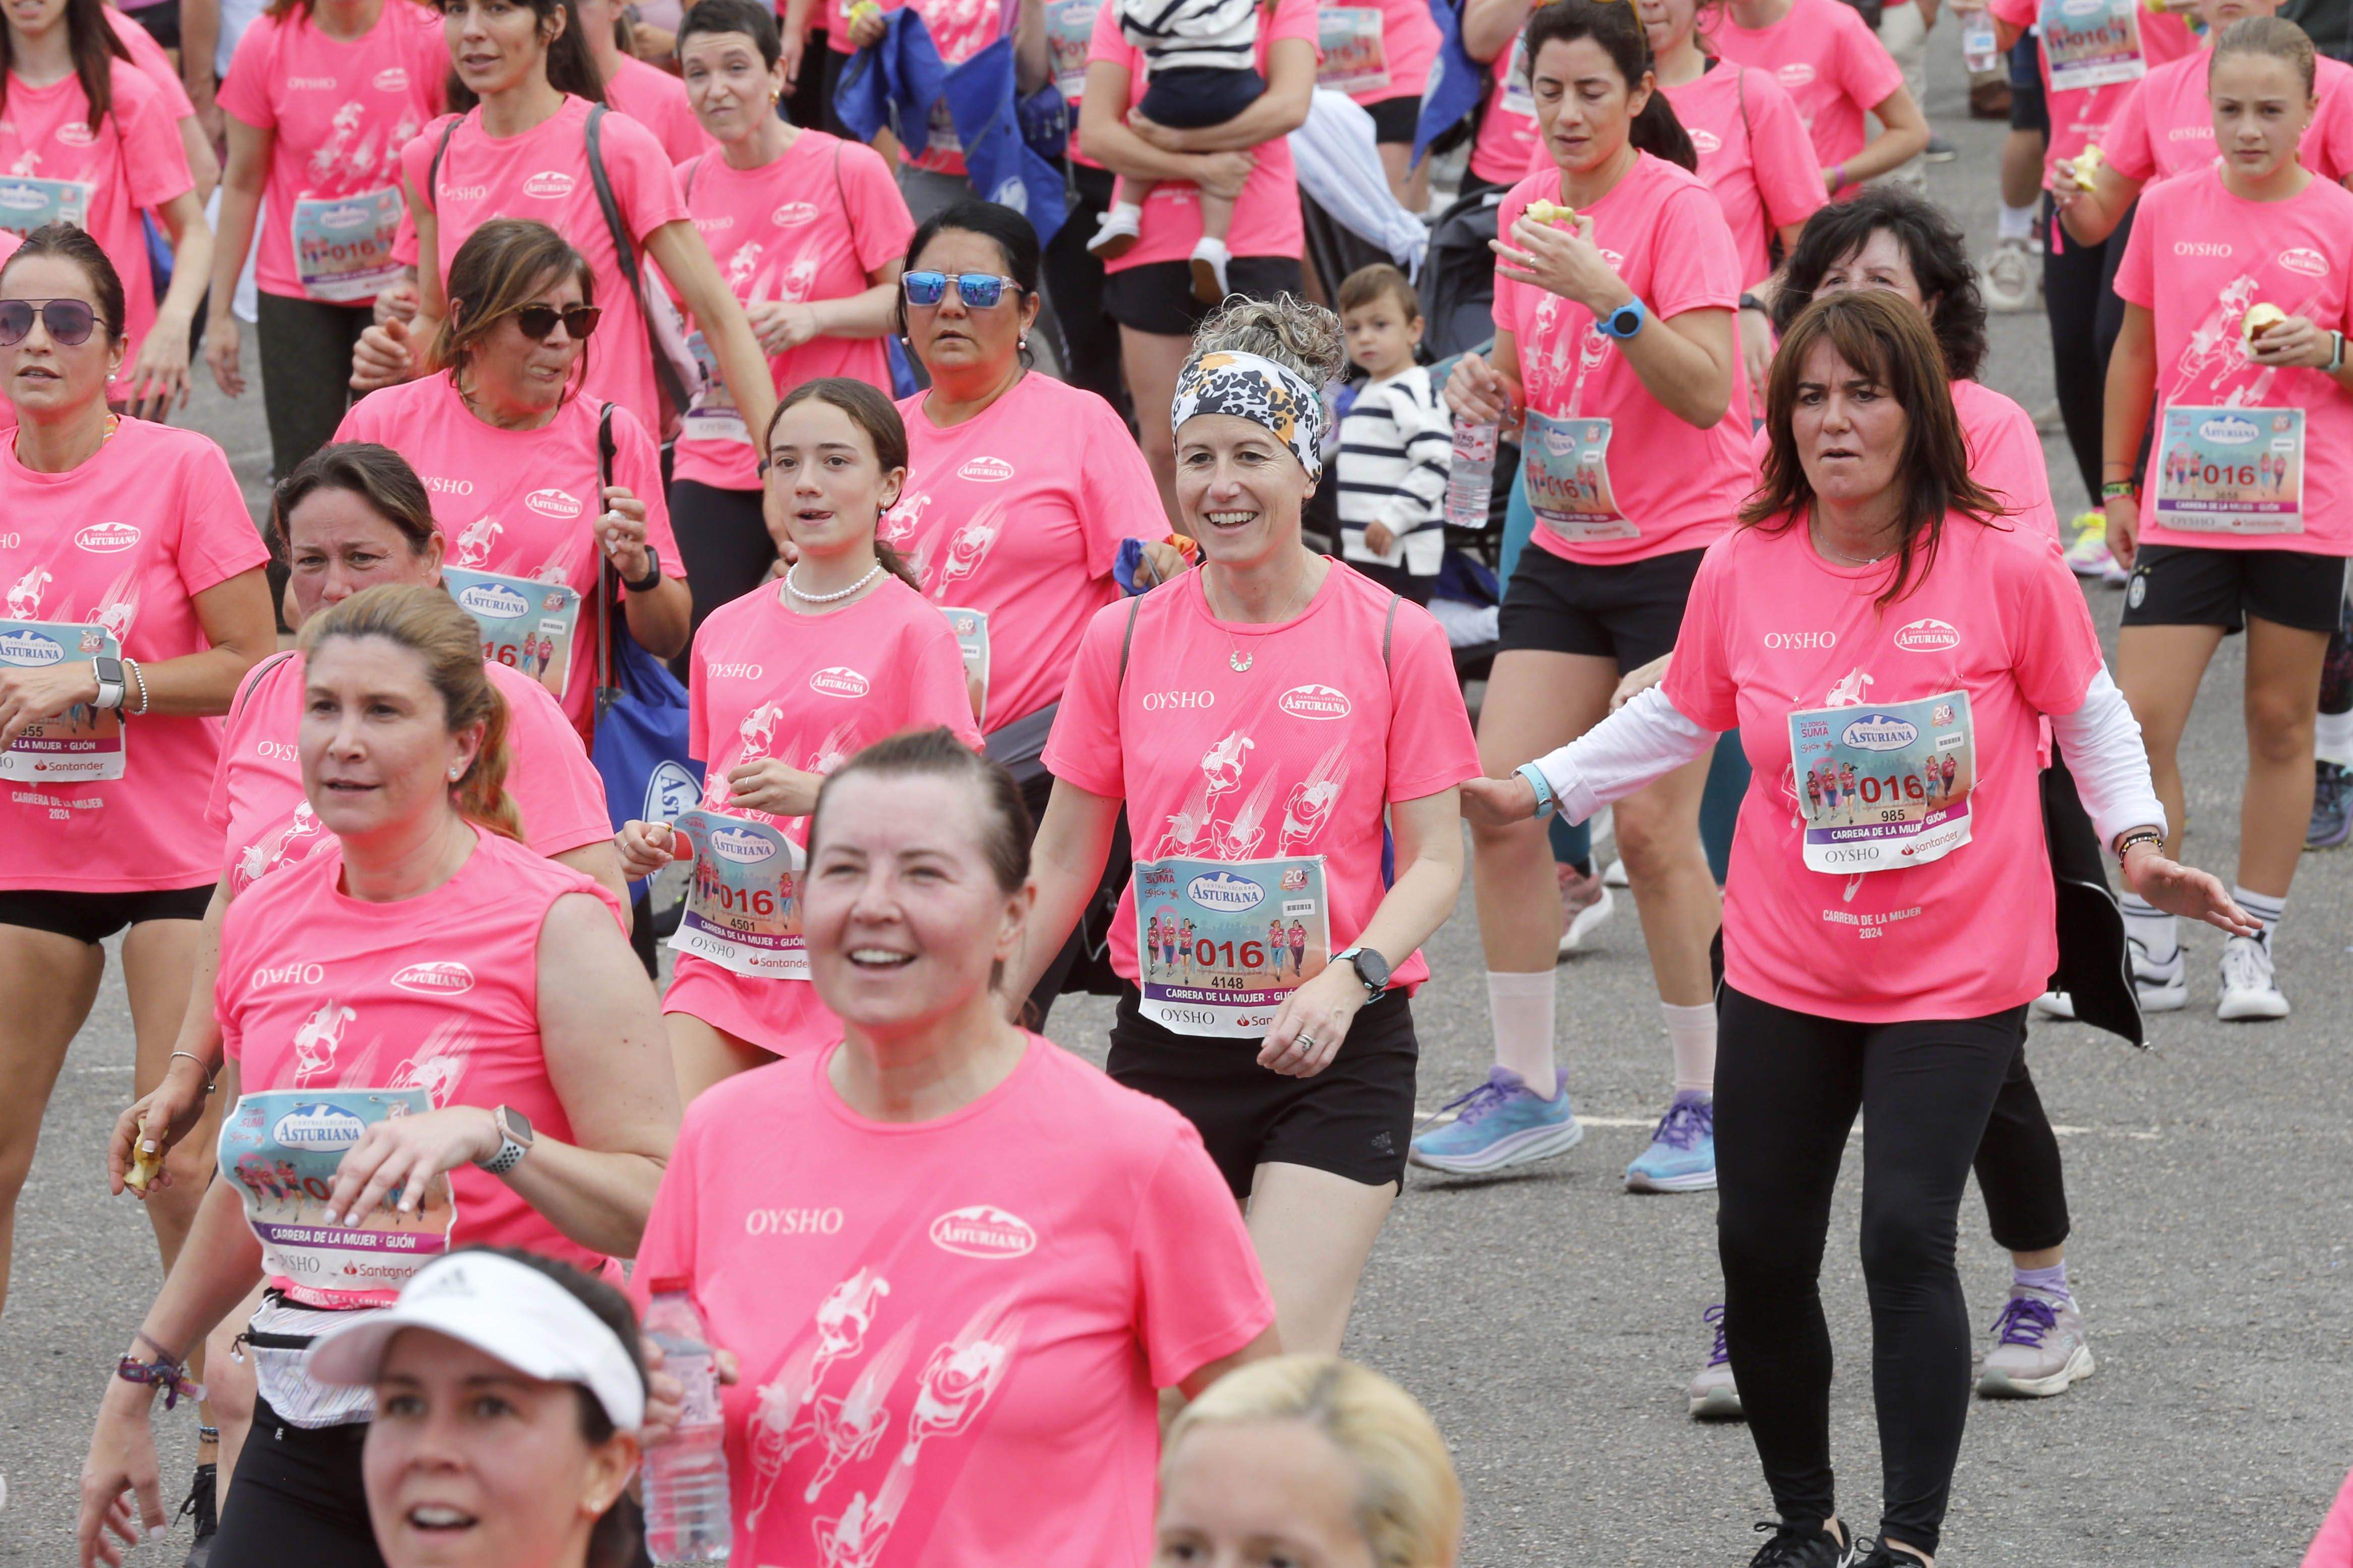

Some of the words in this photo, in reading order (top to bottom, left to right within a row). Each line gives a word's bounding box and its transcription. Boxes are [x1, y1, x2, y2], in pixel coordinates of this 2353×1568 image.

[331, 238, 375, 261] 016
[2173, 242, 2232, 258] OYSHO
[2203, 464, 2256, 486] 016
[531, 495, 578, 514] ASTURIANA
[80, 533, 136, 546] ASTURIANA
[463, 591, 524, 614] ASTURIANA
[546, 593, 562, 605] 20
[958, 618, 973, 630] 20
[83, 635, 100, 647] 20
[1764, 631, 1836, 649] OYSHO
[1899, 632, 1955, 645] ASTURIANA
[482, 641, 517, 667] 16
[707, 664, 762, 680] OYSHO
[813, 675, 864, 694] ASTURIANA
[1143, 690, 1215, 711] OYSHO
[1284, 695, 1345, 713] ASTURIANA
[1935, 705, 1950, 719] 20
[1801, 727, 1829, 738] SUMA
[1848, 729, 1912, 745] ASTURIANA
[19, 741, 30, 749] LA
[32, 741, 62, 750] MUJER
[70, 740, 96, 750] GIJÓN
[49, 762, 104, 771] Santander
[1860, 774, 1924, 803] 016
[12, 791, 48, 806] CARRERA
[50, 796, 62, 807] DE
[49, 808, 70, 820] 2024
[1881, 809, 1905, 822] 985
[1832, 828, 1870, 840] CARRERA
[1872, 826, 1883, 836] DE
[1886, 825, 1897, 835] LA
[1926, 810, 1947, 825] GIJÓN
[714, 835, 771, 856] ASTURIANA
[1825, 847, 1879, 863] OYSHO
[1915, 830, 1958, 854] Santander
[1146, 874, 1175, 884] SUMA
[1285, 870, 1303, 883] 20
[720, 884, 774, 916] 016
[1193, 883, 1259, 903] ASTURIANA
[730, 918, 755, 932] 4501
[1823, 909, 1859, 926] CARRERA
[1861, 915, 1873, 926] DE
[1875, 913, 1888, 924] LA
[1890, 907, 1921, 922] MUJER
[727, 931, 736, 939] DE
[737, 934, 746, 942] LA
[748, 936, 773, 946] MUJER
[780, 935, 805, 946] GIJÓN
[1859, 927, 1883, 939] 2024
[691, 936, 735, 958] OYSHO
[760, 957, 809, 969] Santande
[1196, 938, 1264, 968] 016
[1211, 976, 1244, 989] 4148
[1166, 988, 1204, 1001] CARRERA
[1206, 990, 1217, 1001] DE
[1219, 991, 1231, 1002] LA
[1233, 991, 1265, 1003] MUJER
[1161, 1008, 1215, 1025] OYSHO
[278, 1122, 360, 1141] ASTURIANA
[745, 1208, 843, 1235] OYSHO
[271, 1228, 311, 1242] CARRERA
[313, 1231, 326, 1243] DE
[328, 1232, 340, 1244] LA
[343, 1233, 377, 1246] MUJER
[386, 1233, 416, 1248] GIJÓN
[935, 1221, 1027, 1250] ASTURIANA
